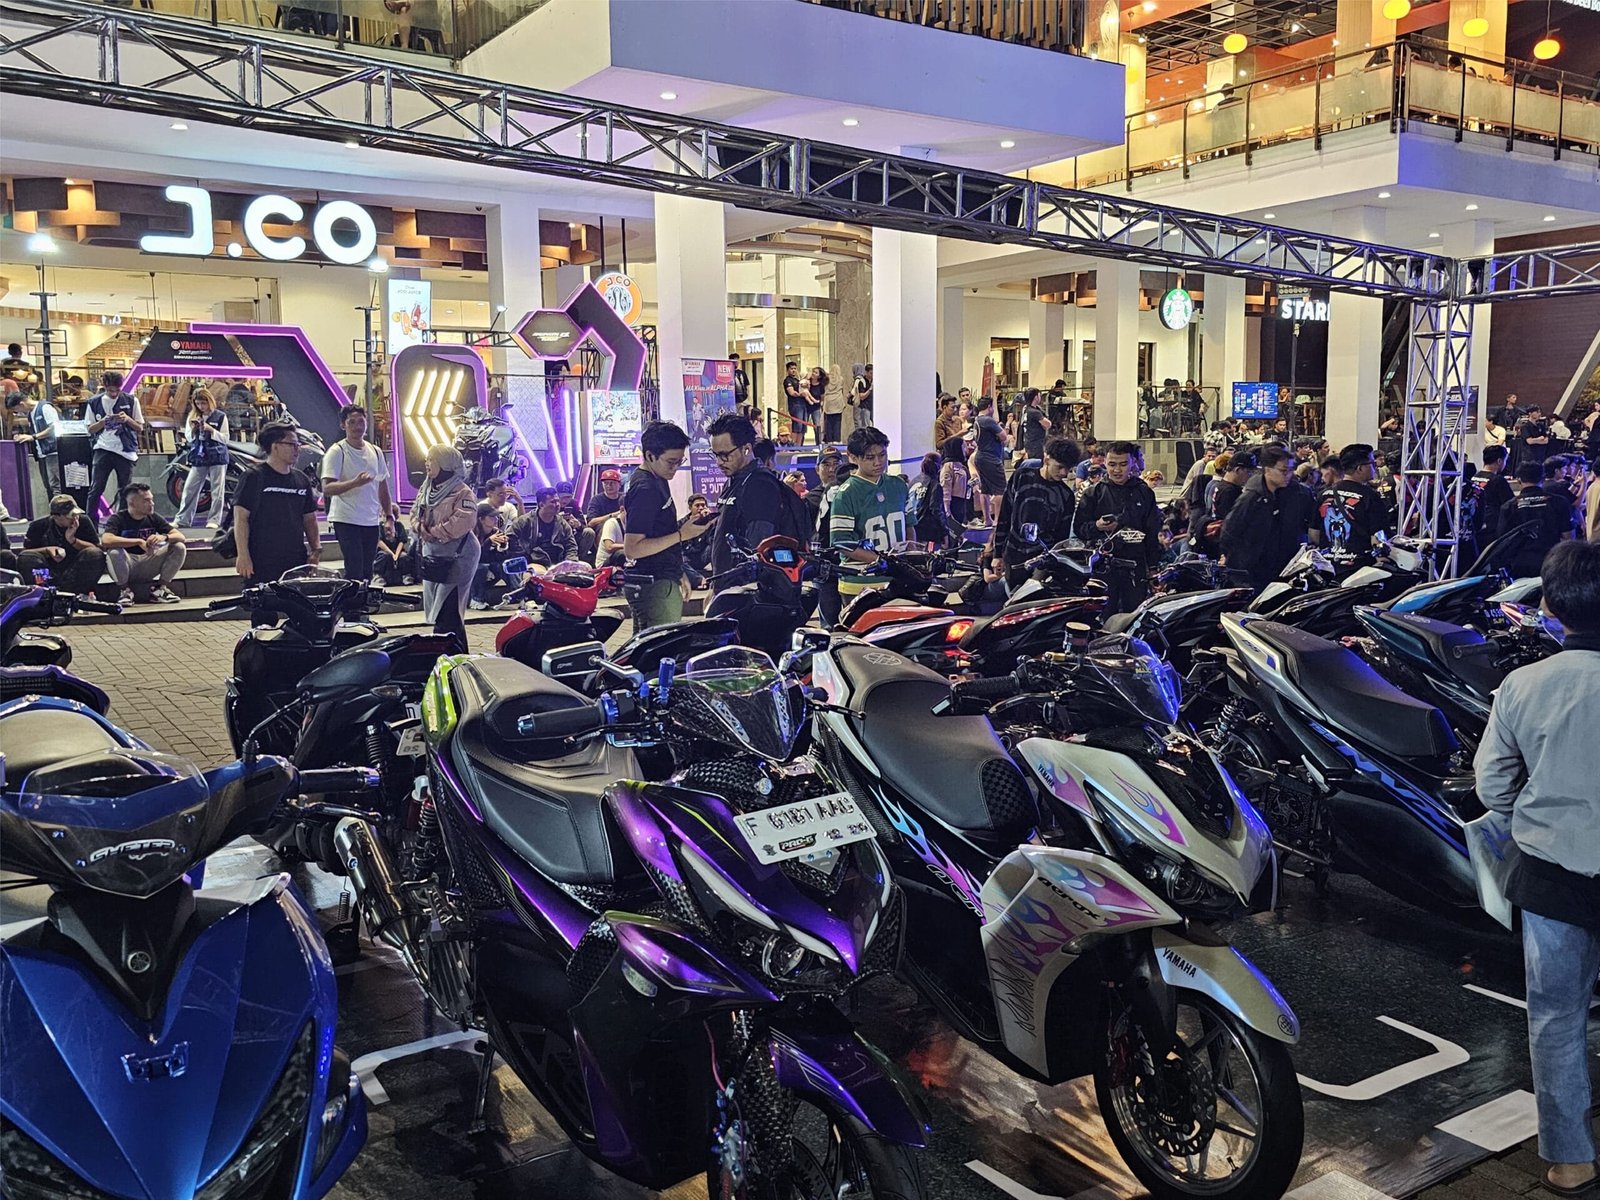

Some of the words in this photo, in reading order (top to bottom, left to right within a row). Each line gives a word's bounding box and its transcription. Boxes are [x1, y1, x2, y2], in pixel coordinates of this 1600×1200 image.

[140, 184, 377, 265] J.CO
[180, 341, 212, 350] YAMAHA
[864, 511, 907, 553] 60
[1037, 763, 1056, 789] YAMAHA
[741, 816, 758, 837] F
[1037, 876, 1101, 920] aerox
[1162, 947, 1198, 979] YAMAHA
